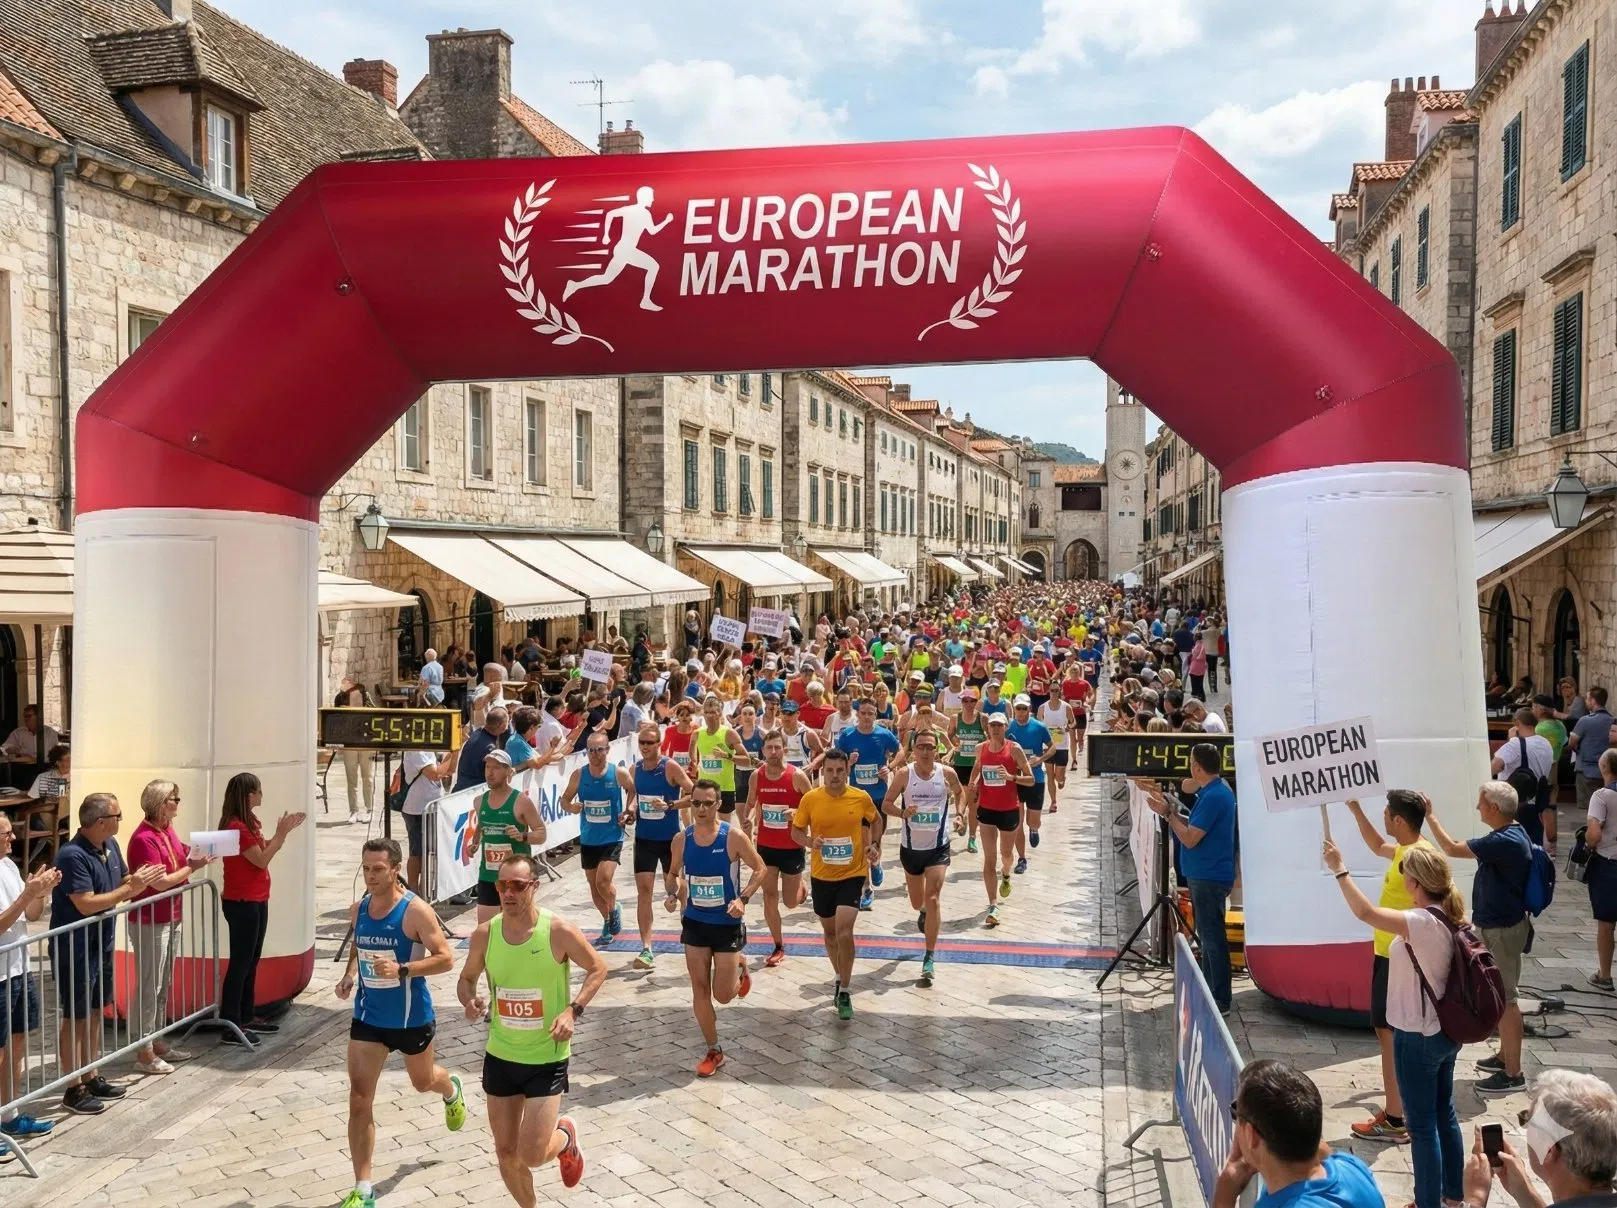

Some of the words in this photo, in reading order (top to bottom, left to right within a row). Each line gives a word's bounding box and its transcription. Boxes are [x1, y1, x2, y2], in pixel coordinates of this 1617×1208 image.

[683, 187, 965, 244] EUROPEAN
[679, 240, 962, 296] MARATHON
[1262, 724, 1368, 766] EUROPEAN
[1271, 759, 1381, 801] MARATHON
[505, 1002, 534, 1017] 105
